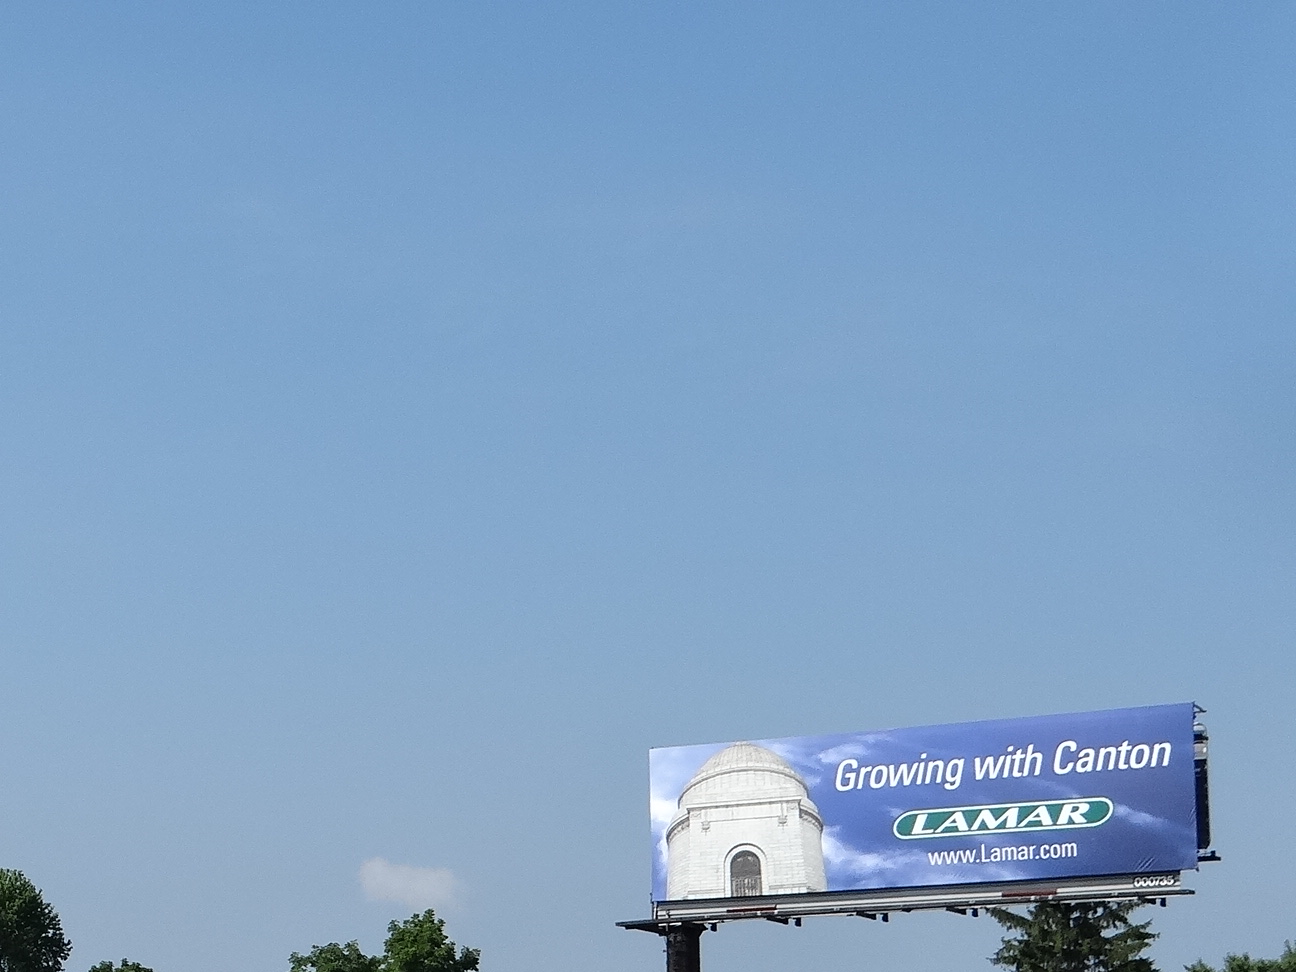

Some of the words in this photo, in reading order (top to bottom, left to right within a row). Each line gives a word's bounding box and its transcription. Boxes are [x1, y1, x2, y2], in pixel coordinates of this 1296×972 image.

[835, 753, 964, 791] Growing
[975, 743, 1043, 780] with
[1054, 739, 1172, 775] Canton
[911, 801, 1090, 836] LAMAR
[927, 842, 1078, 866] www.Lamar.com
[1134, 875, 1174, 887] 000735
